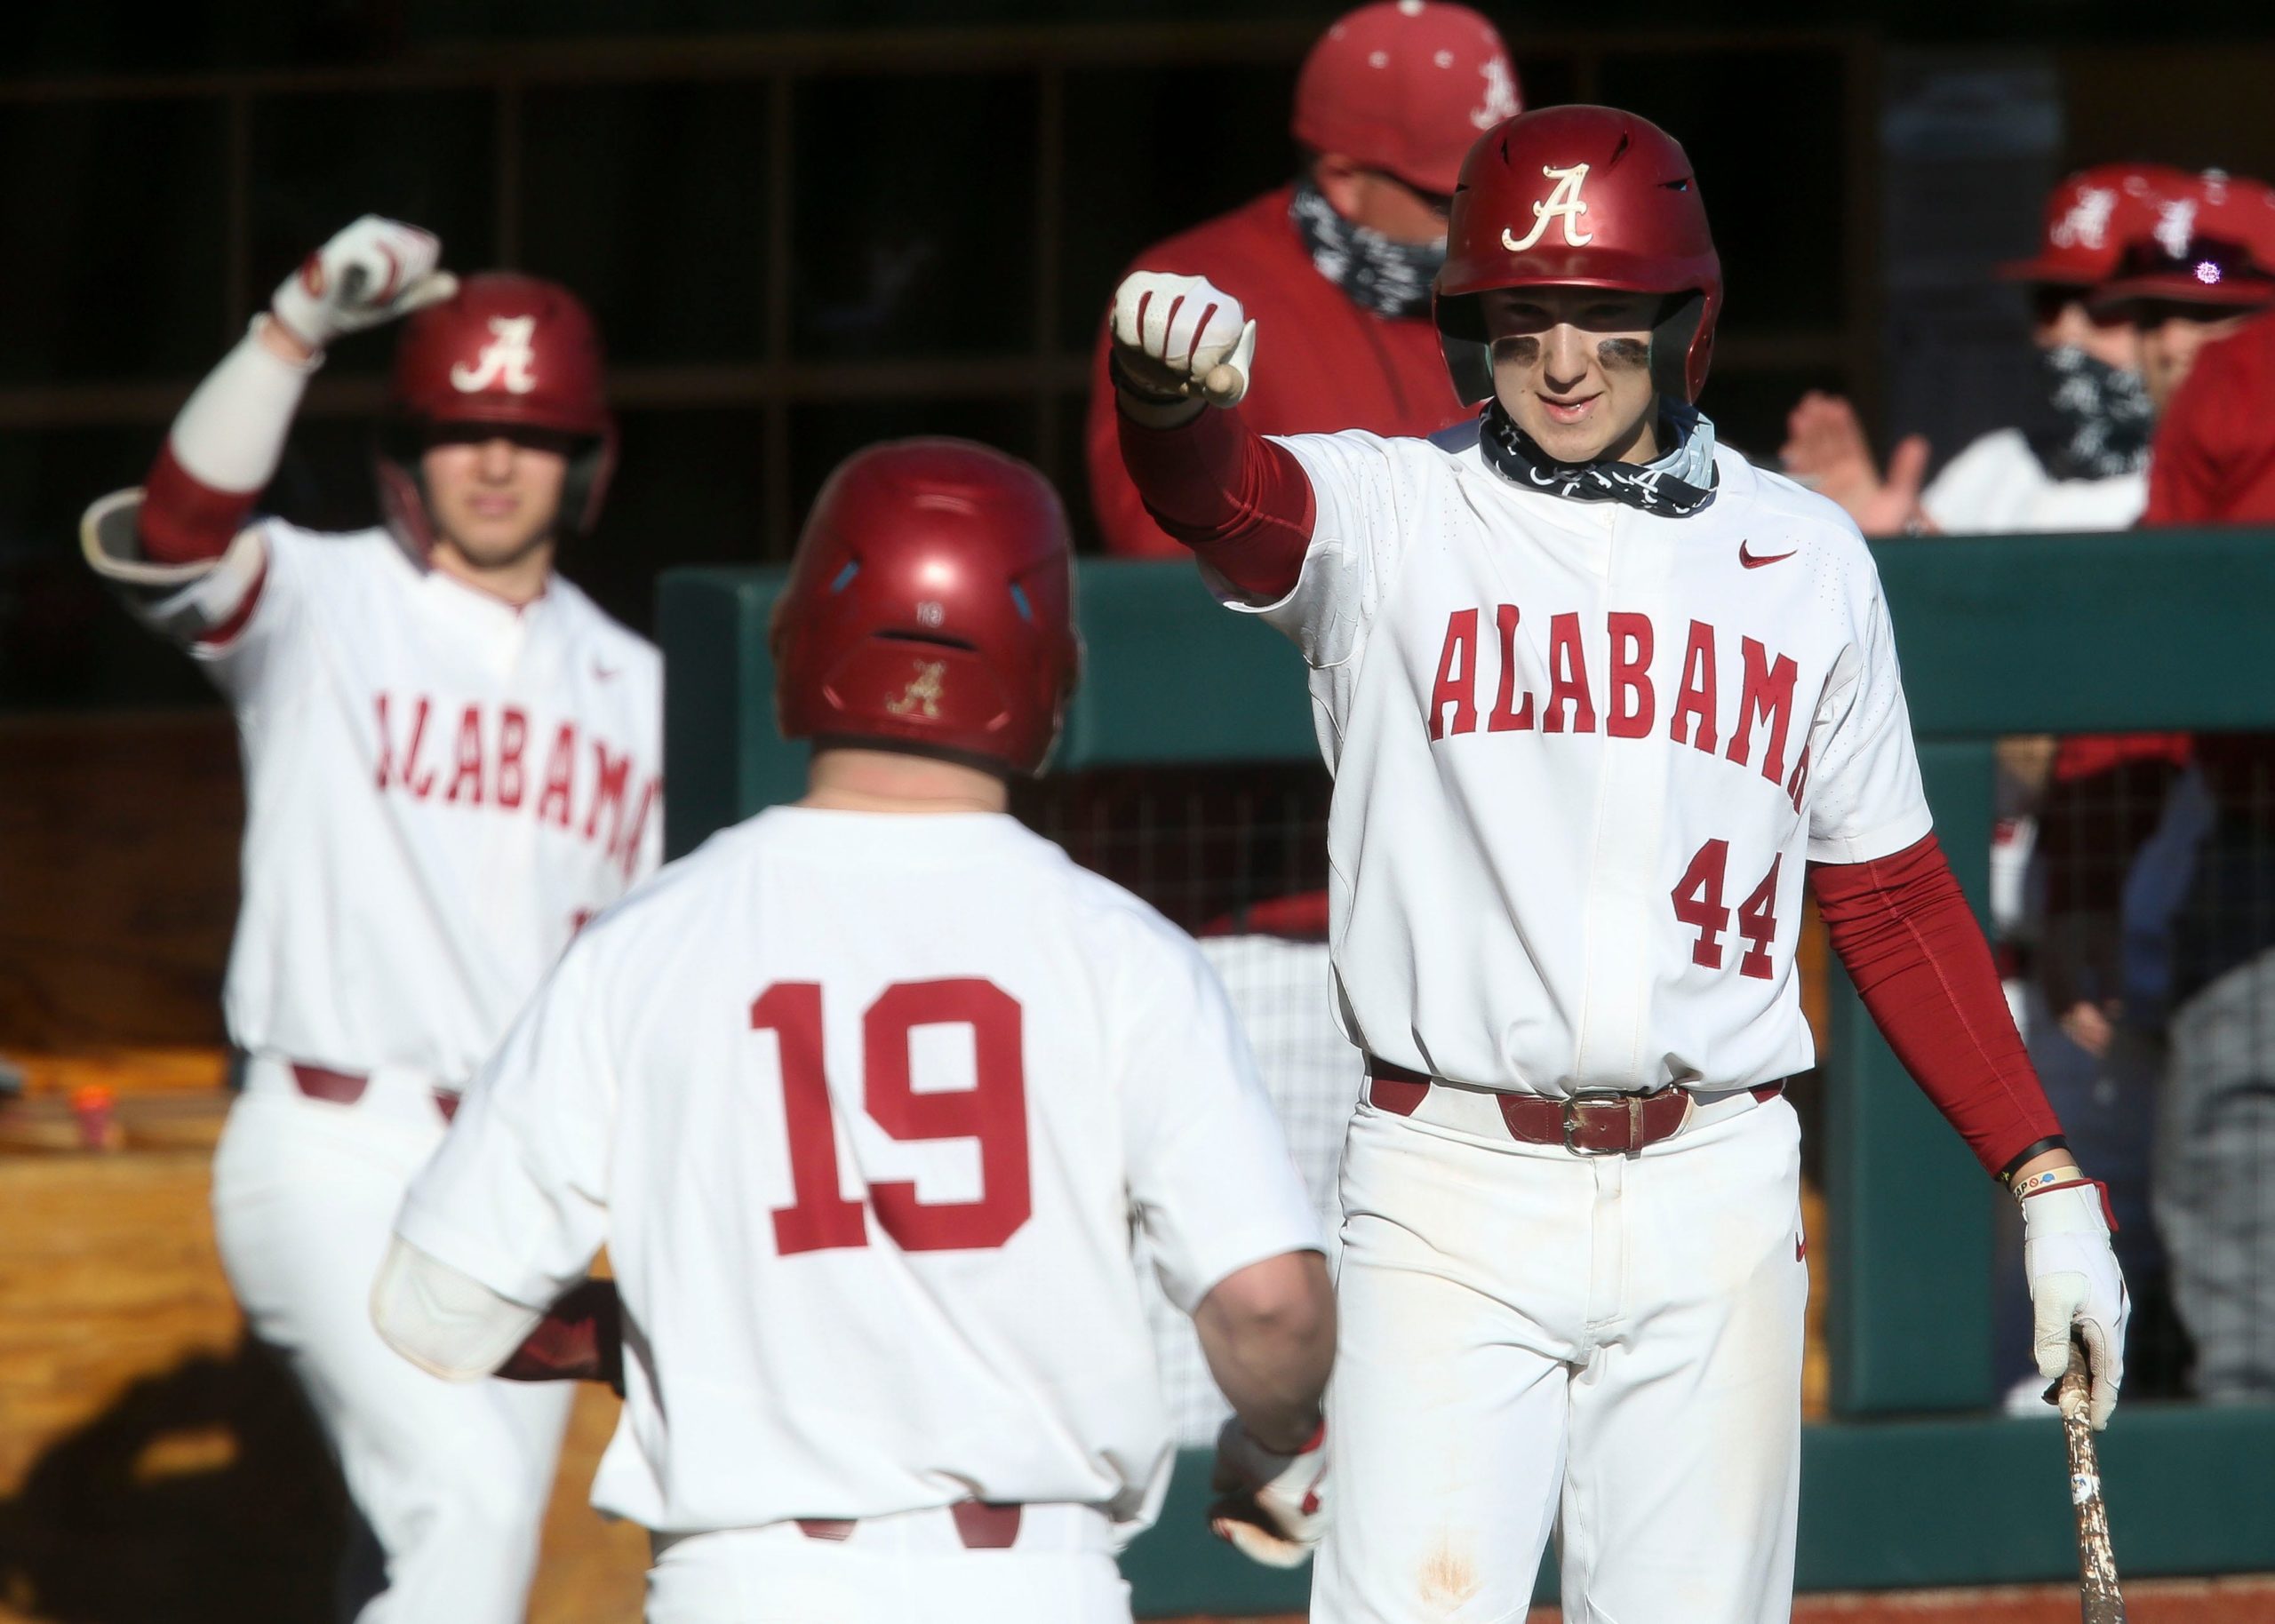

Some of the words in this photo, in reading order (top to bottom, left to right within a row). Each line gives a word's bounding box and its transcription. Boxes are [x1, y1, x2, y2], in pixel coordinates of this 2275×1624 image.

[1501, 163, 1592, 251] A
[451, 314, 536, 394] A
[886, 659, 946, 718] A
[1671, 838, 1783, 980] 44
[751, 979, 1032, 1255] 19
